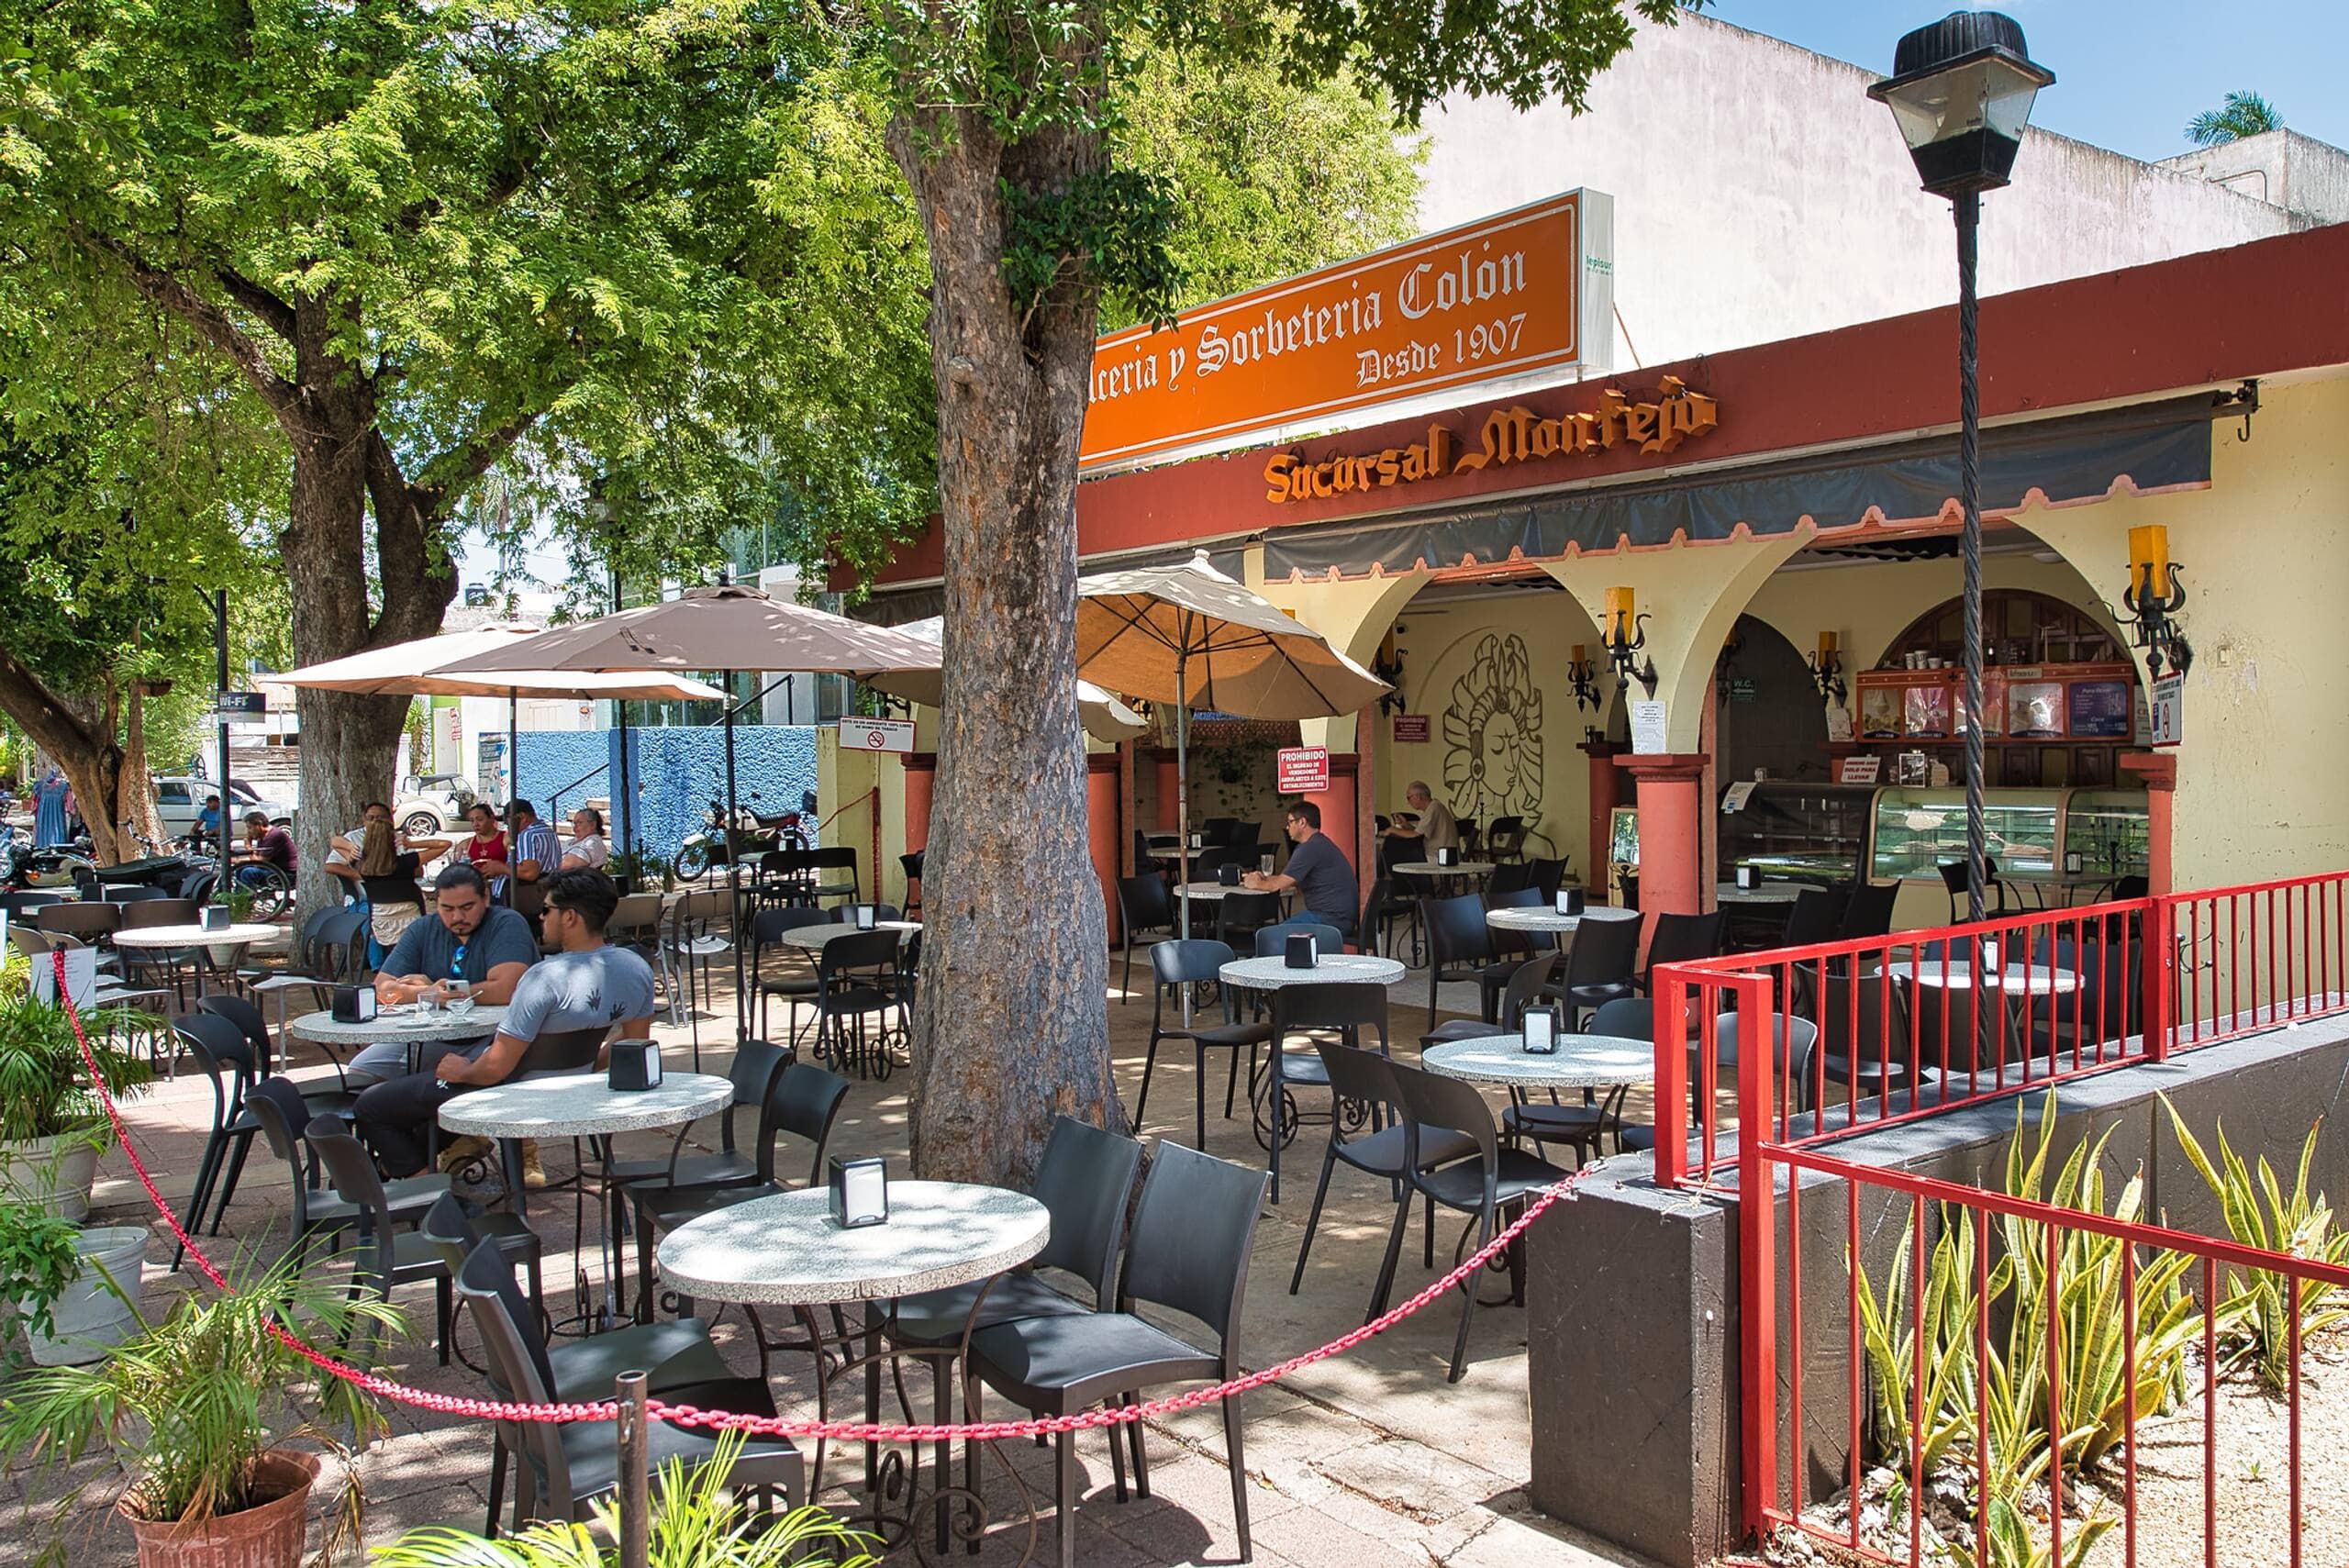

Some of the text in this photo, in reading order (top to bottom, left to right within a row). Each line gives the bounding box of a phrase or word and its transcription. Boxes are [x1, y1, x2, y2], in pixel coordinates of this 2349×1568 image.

[1168, 345, 1186, 392] y
[1356, 312, 1528, 388] Desde 1907
[1264, 374, 1718, 504] Sucursal Montejo
[1281, 751, 1325, 762] PROHIBIDO
